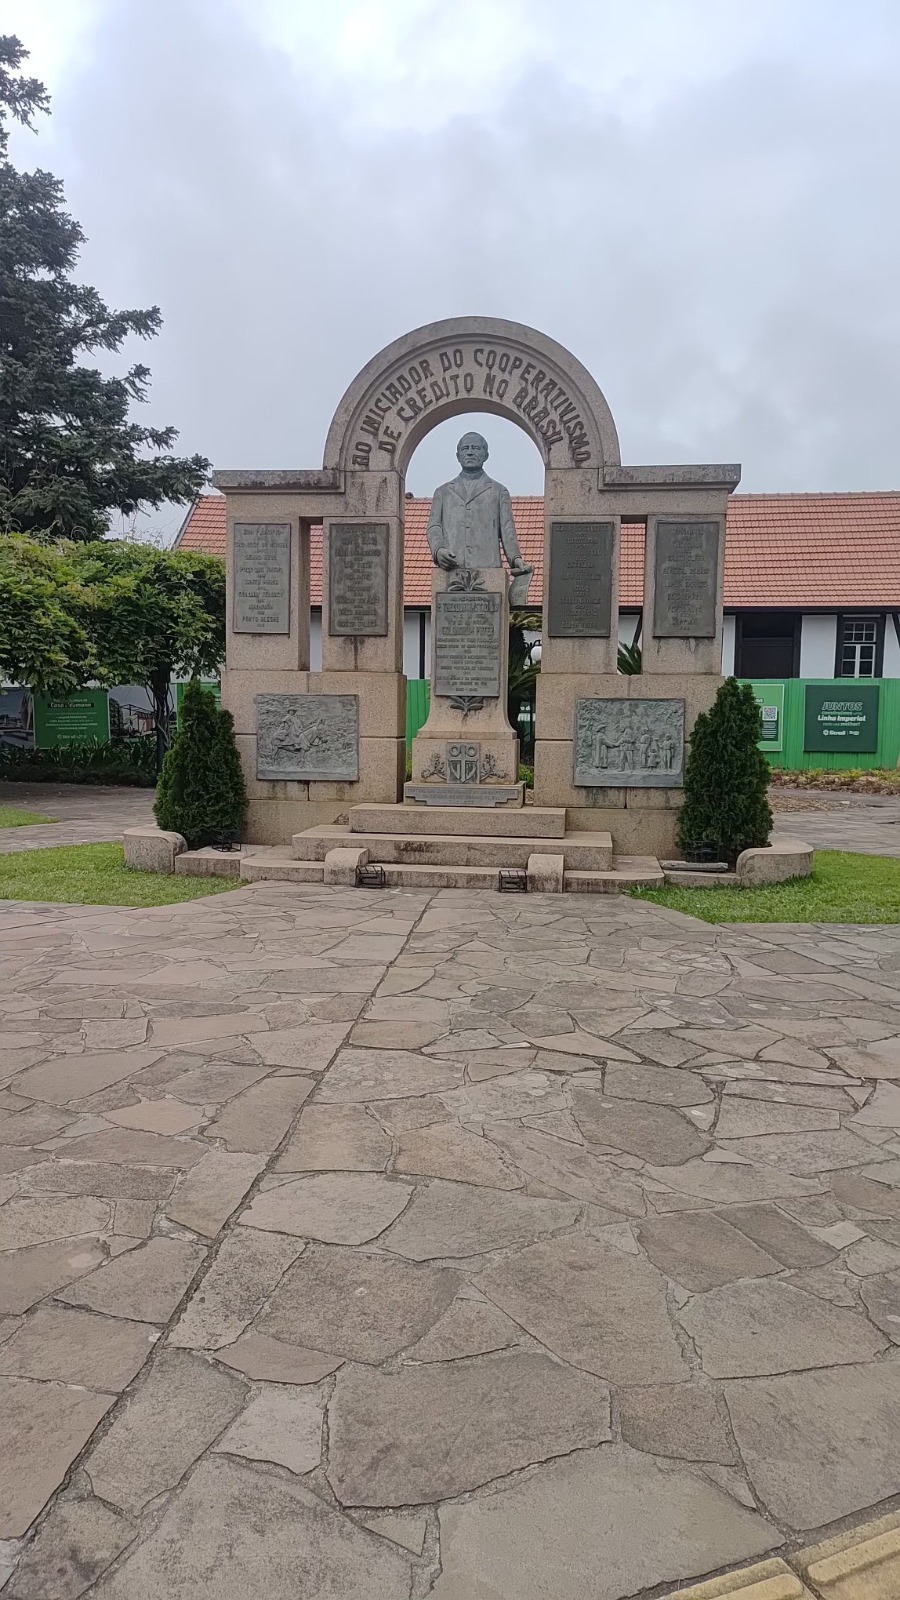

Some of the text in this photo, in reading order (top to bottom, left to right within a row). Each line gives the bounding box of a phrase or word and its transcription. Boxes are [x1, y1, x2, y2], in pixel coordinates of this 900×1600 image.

[352, 348, 591, 466] AO INICIADOR DO COOPERATIVISMO
[378, 372, 563, 453] DE CREDITO NO BRASIL
[821, 702, 863, 711] JUNTOS
